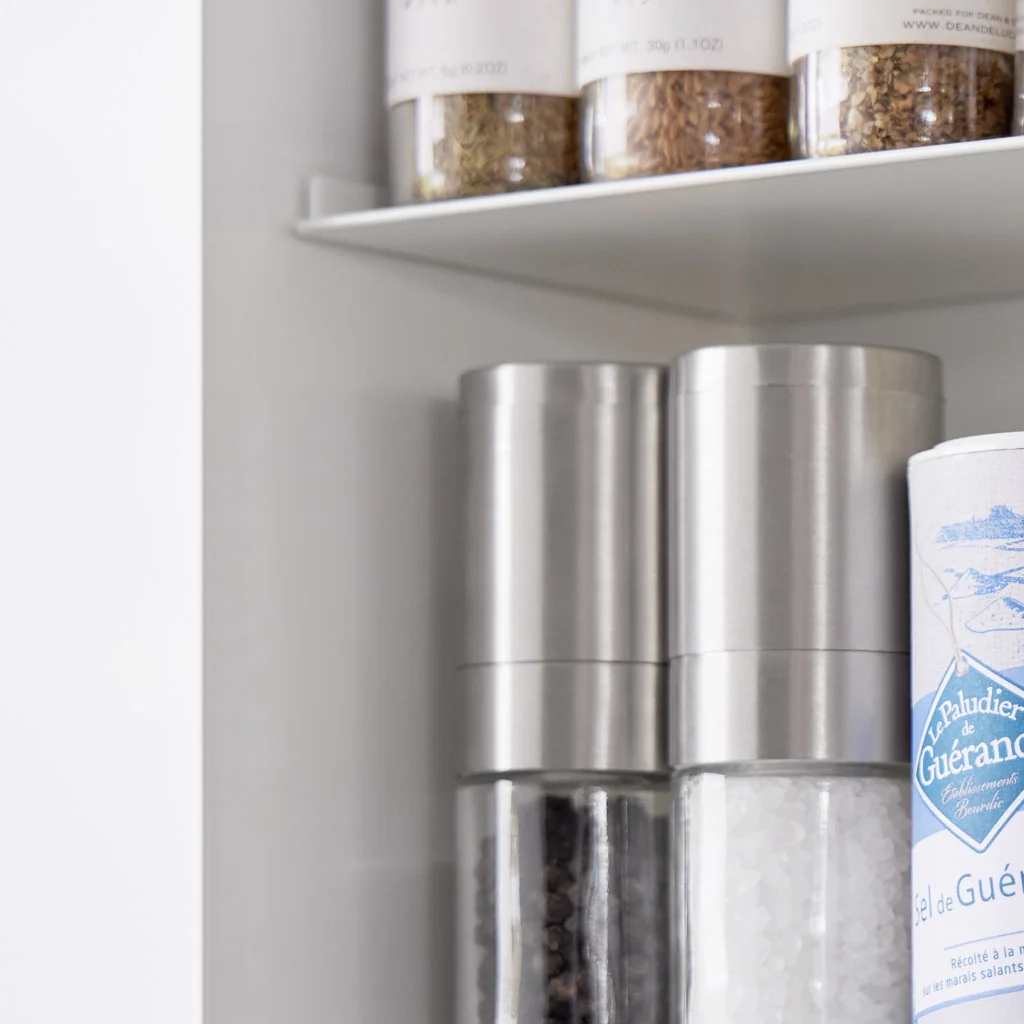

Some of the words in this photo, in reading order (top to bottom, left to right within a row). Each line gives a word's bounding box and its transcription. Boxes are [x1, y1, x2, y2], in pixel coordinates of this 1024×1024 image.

[928, 720, 945, 746] Le
[939, 686, 1024, 728] Paludier
[961, 720, 975, 736] de
[937, 892, 954, 915] de
[950, 950, 989, 970] Récolté
[993, 949, 1000, 961] à
[1003, 946, 1015, 958] la
[946, 971, 977, 989] marais
[980, 961, 1024, 979] salants
